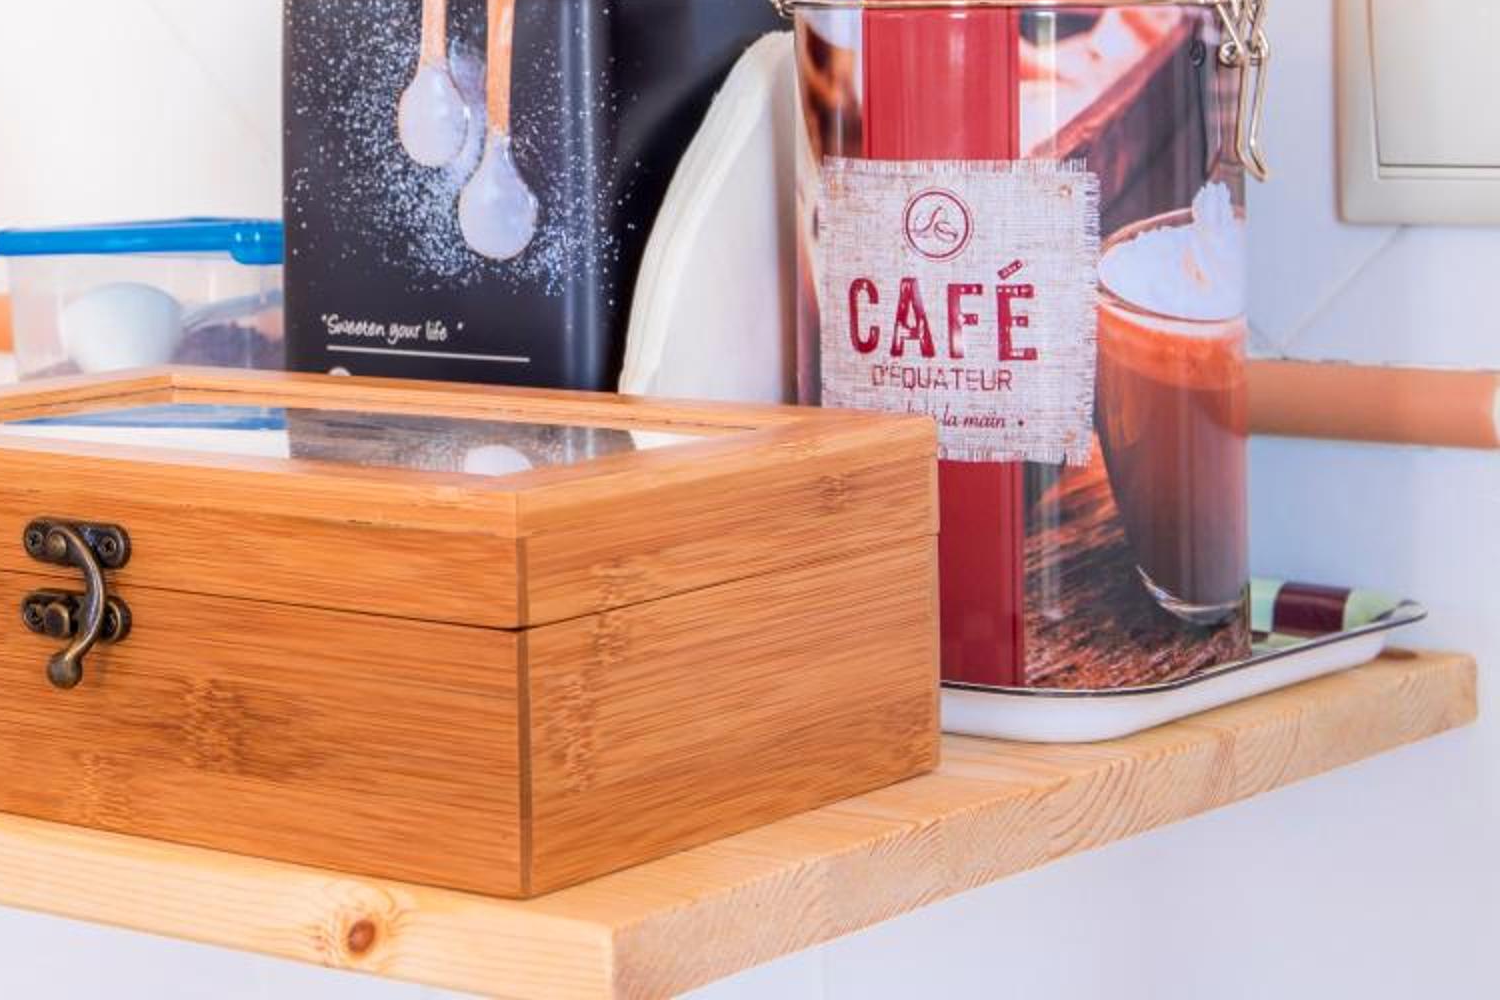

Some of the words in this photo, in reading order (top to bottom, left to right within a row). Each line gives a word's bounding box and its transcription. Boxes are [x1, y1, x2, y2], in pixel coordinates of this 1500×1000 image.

[388, 323, 421, 345] your
[425, 319, 447, 341] life
[849, 259, 1038, 361] CAFÉ
